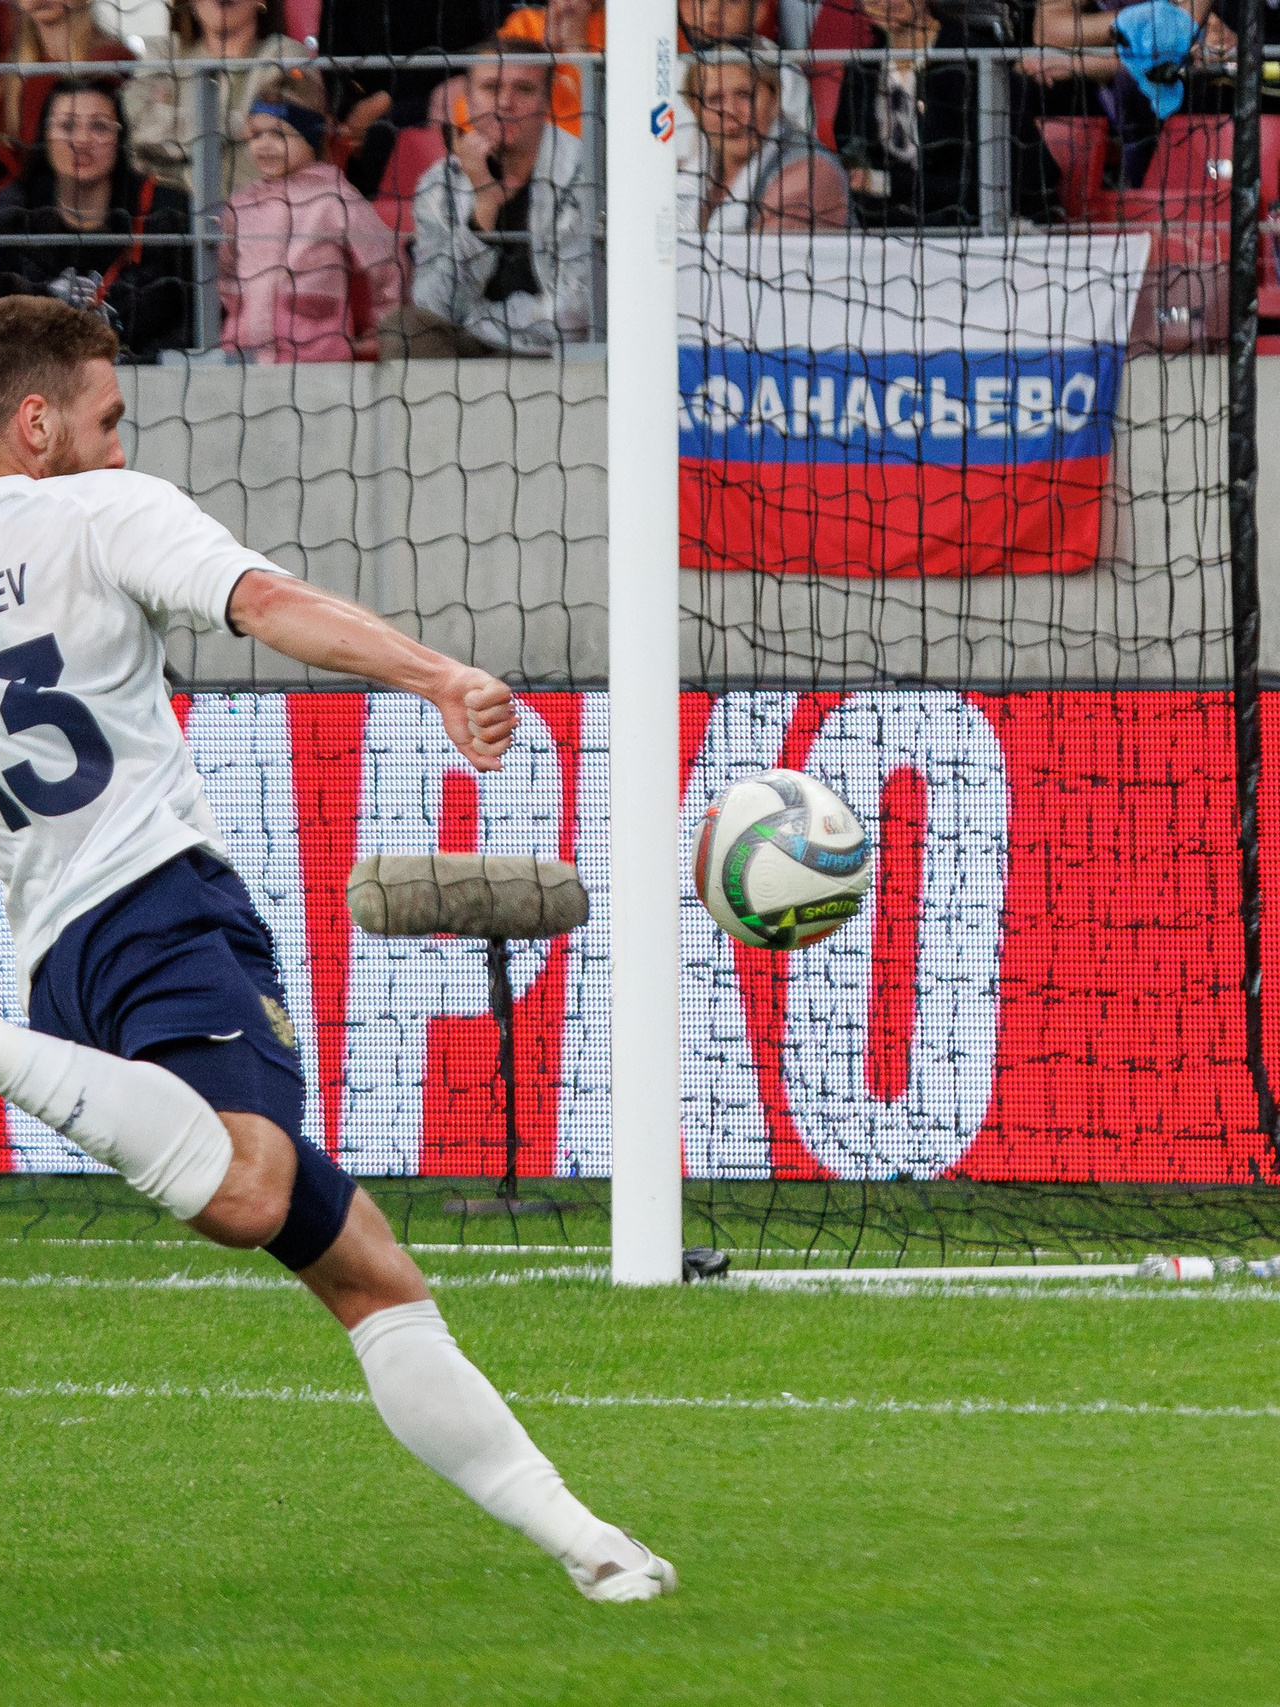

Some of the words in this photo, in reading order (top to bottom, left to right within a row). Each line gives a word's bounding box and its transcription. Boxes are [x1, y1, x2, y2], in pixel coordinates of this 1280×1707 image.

[817, 847, 866, 870] EAGUE
[728, 842, 753, 905] LEAGUE
[802, 900, 858, 919] ATIONS
